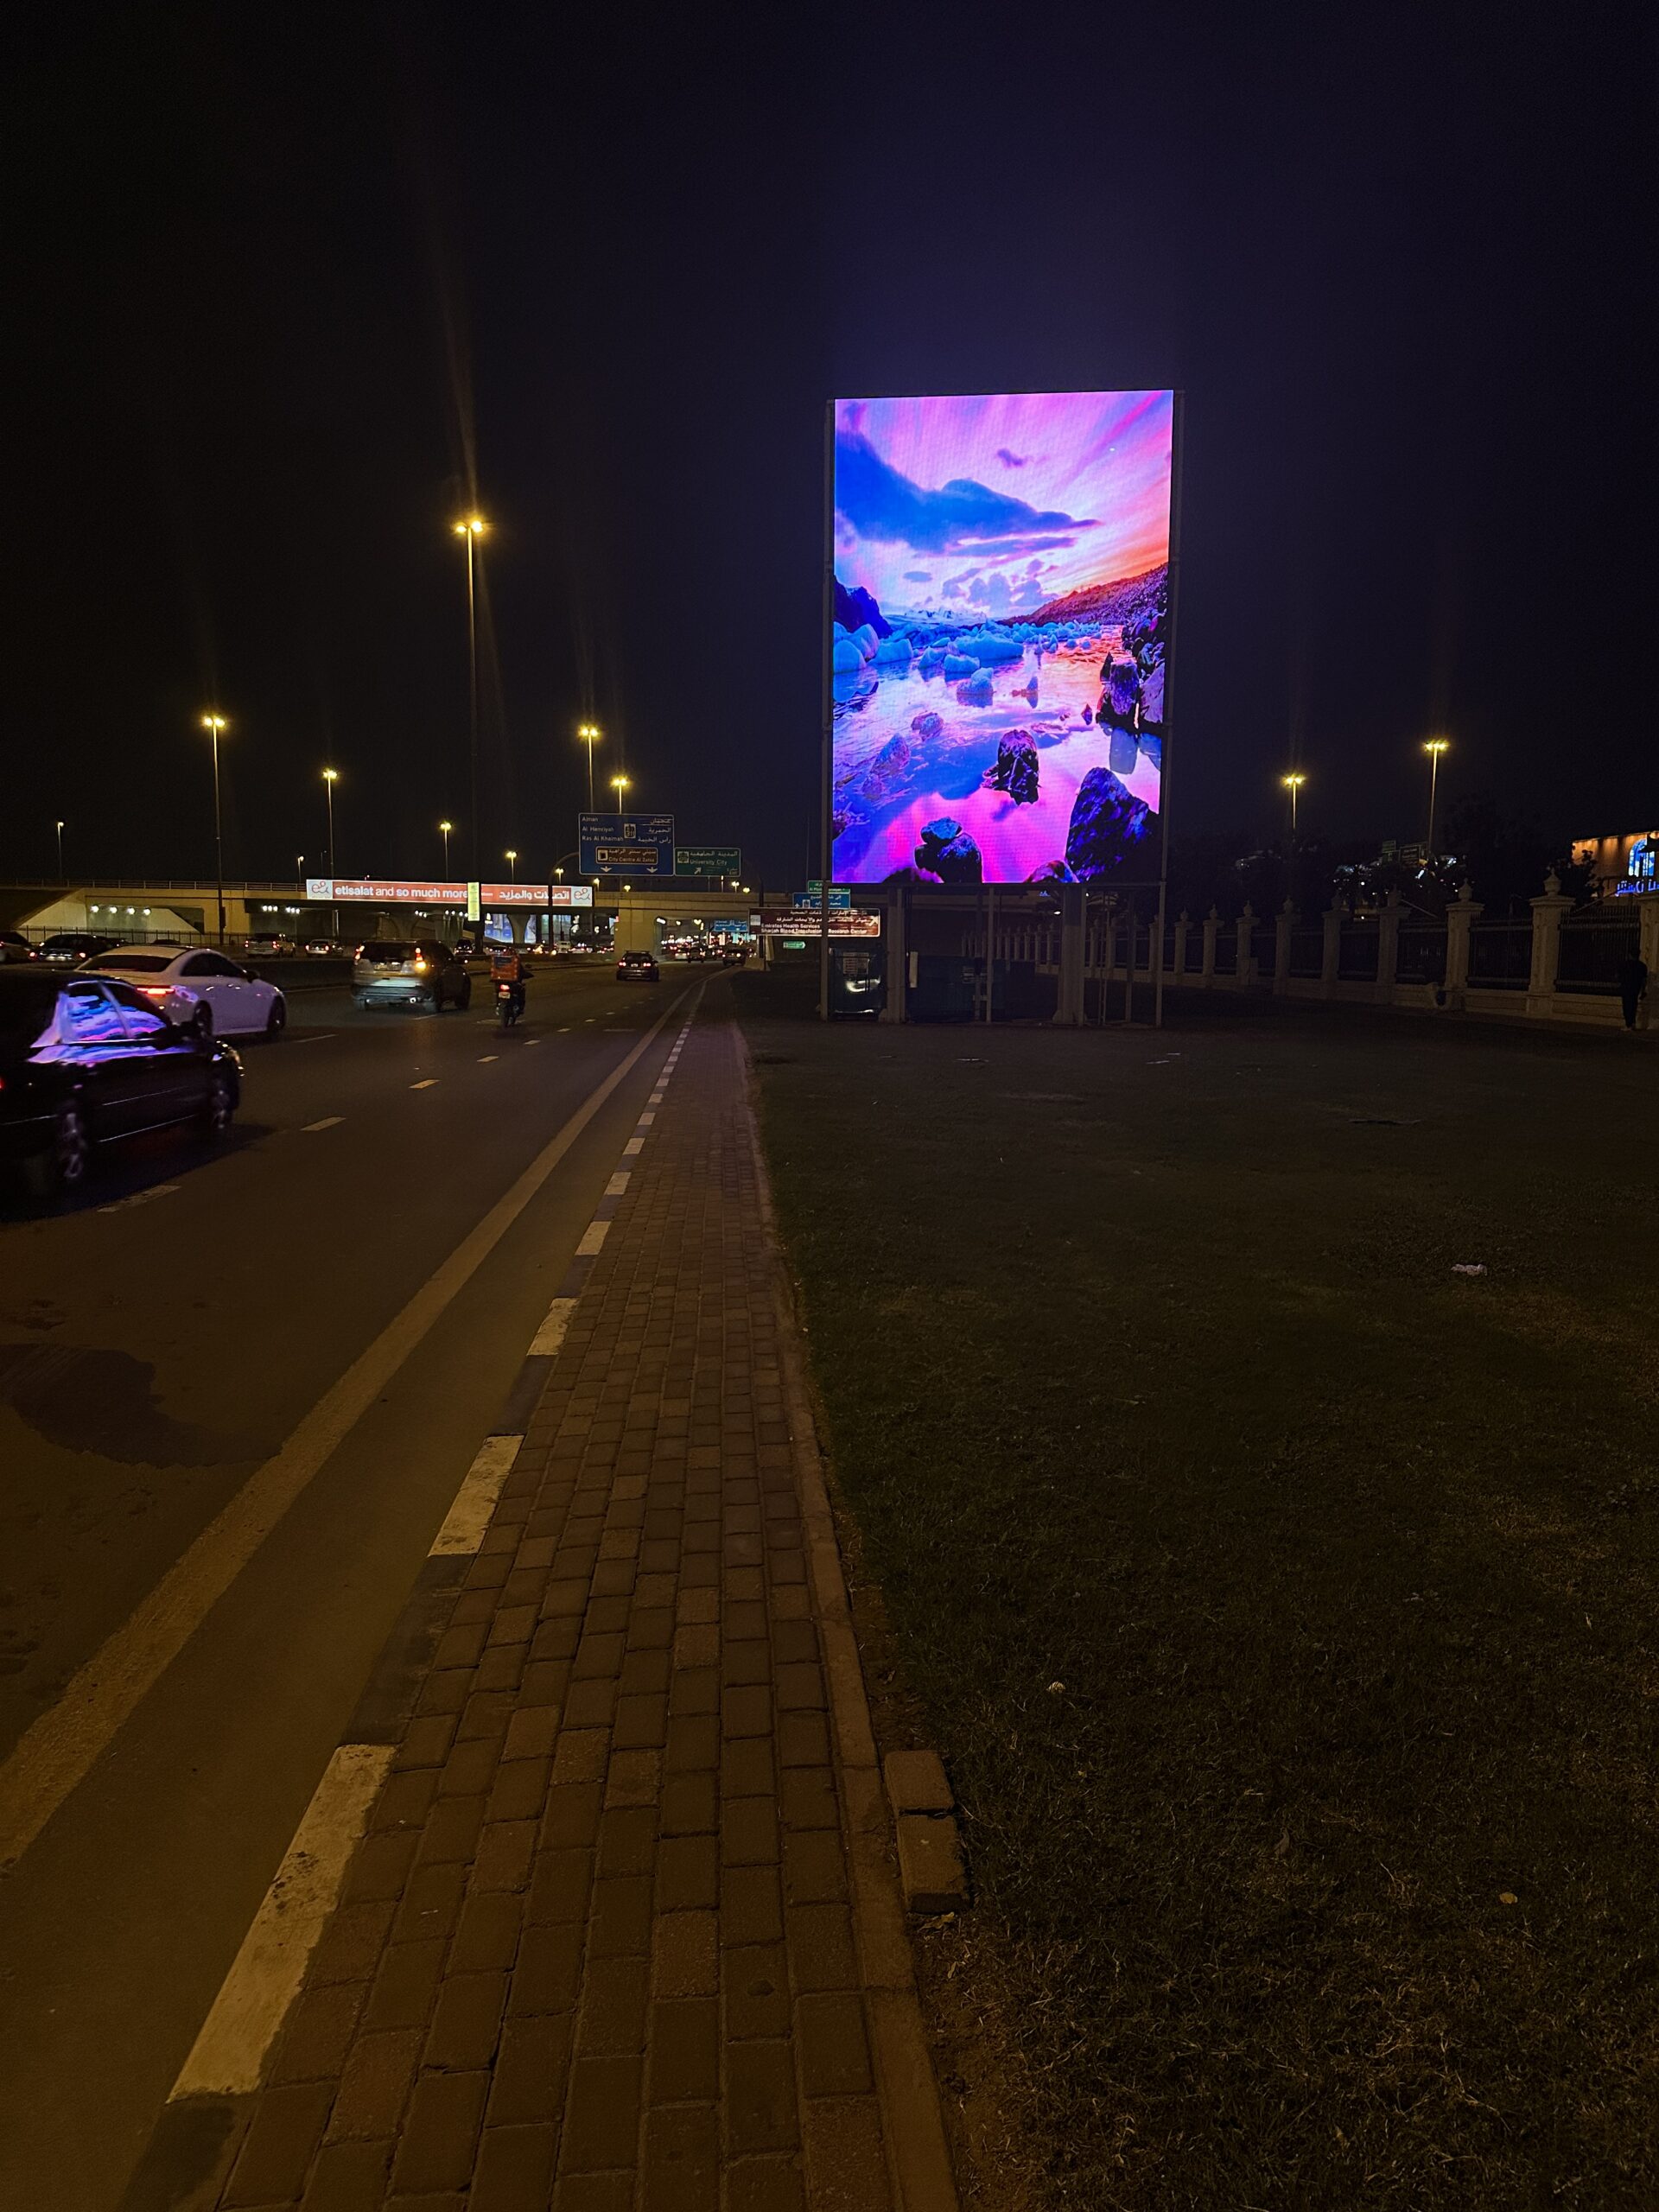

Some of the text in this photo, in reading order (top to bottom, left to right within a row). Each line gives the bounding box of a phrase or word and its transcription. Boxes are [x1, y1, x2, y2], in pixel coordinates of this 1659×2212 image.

[334, 885, 374, 896] etisalat
[375, 887, 394, 897] and
[410, 887, 441, 898] much
[442, 890, 468, 899] more
[499, 890, 569, 900] اتصلات والمزيد
